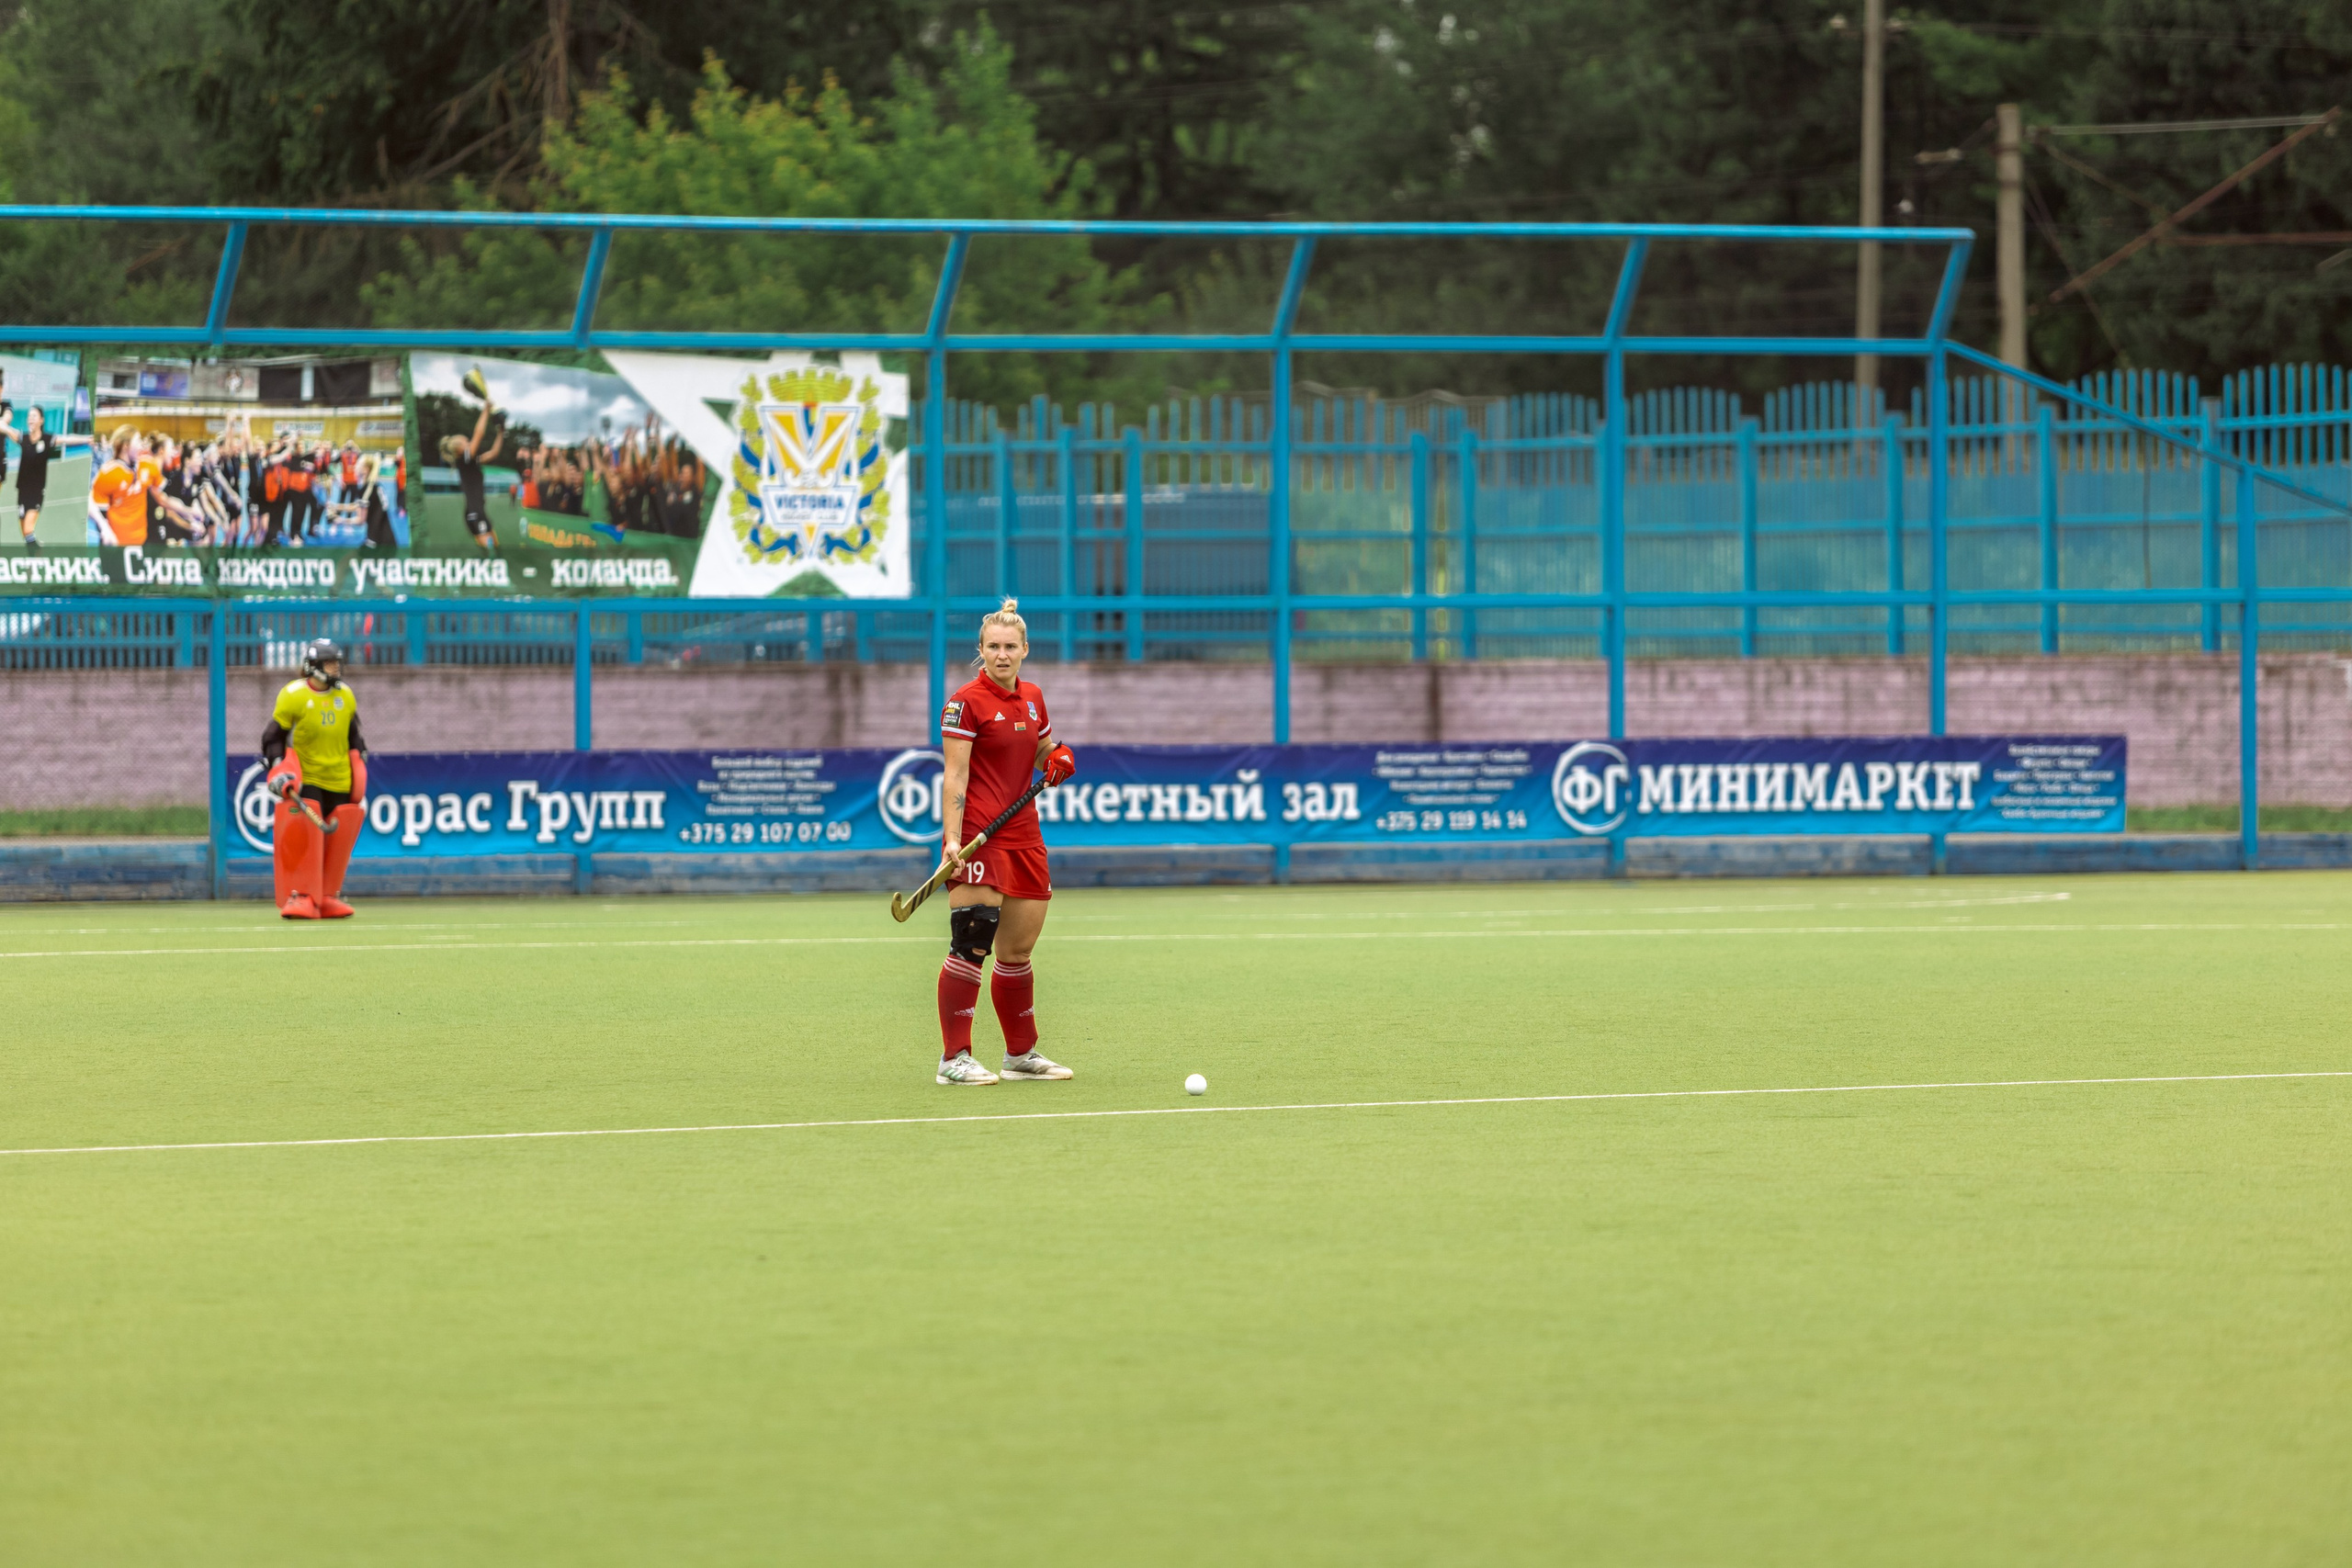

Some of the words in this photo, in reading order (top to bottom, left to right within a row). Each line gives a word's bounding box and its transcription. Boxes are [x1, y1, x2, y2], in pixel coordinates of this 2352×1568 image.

[775, 494, 844, 509] VICTORIA
[123, 546, 203, 584] Сила
[349, 558, 511, 594] участника
[1282, 782, 1359, 821] зал
[1564, 761, 1627, 814] ФГ
[1638, 761, 1982, 814] МИНИМАРКЕТ
[359, 792, 492, 846] орас
[506, 780, 666, 843] Групп
[679, 822, 727, 843] +375
[731, 822, 753, 842] 29
[760, 822, 794, 842] 107
[797, 821, 822, 842] 07
[826, 820, 852, 841] 00
[1420, 811, 1443, 830] 29
[966, 861, 985, 884] 19
